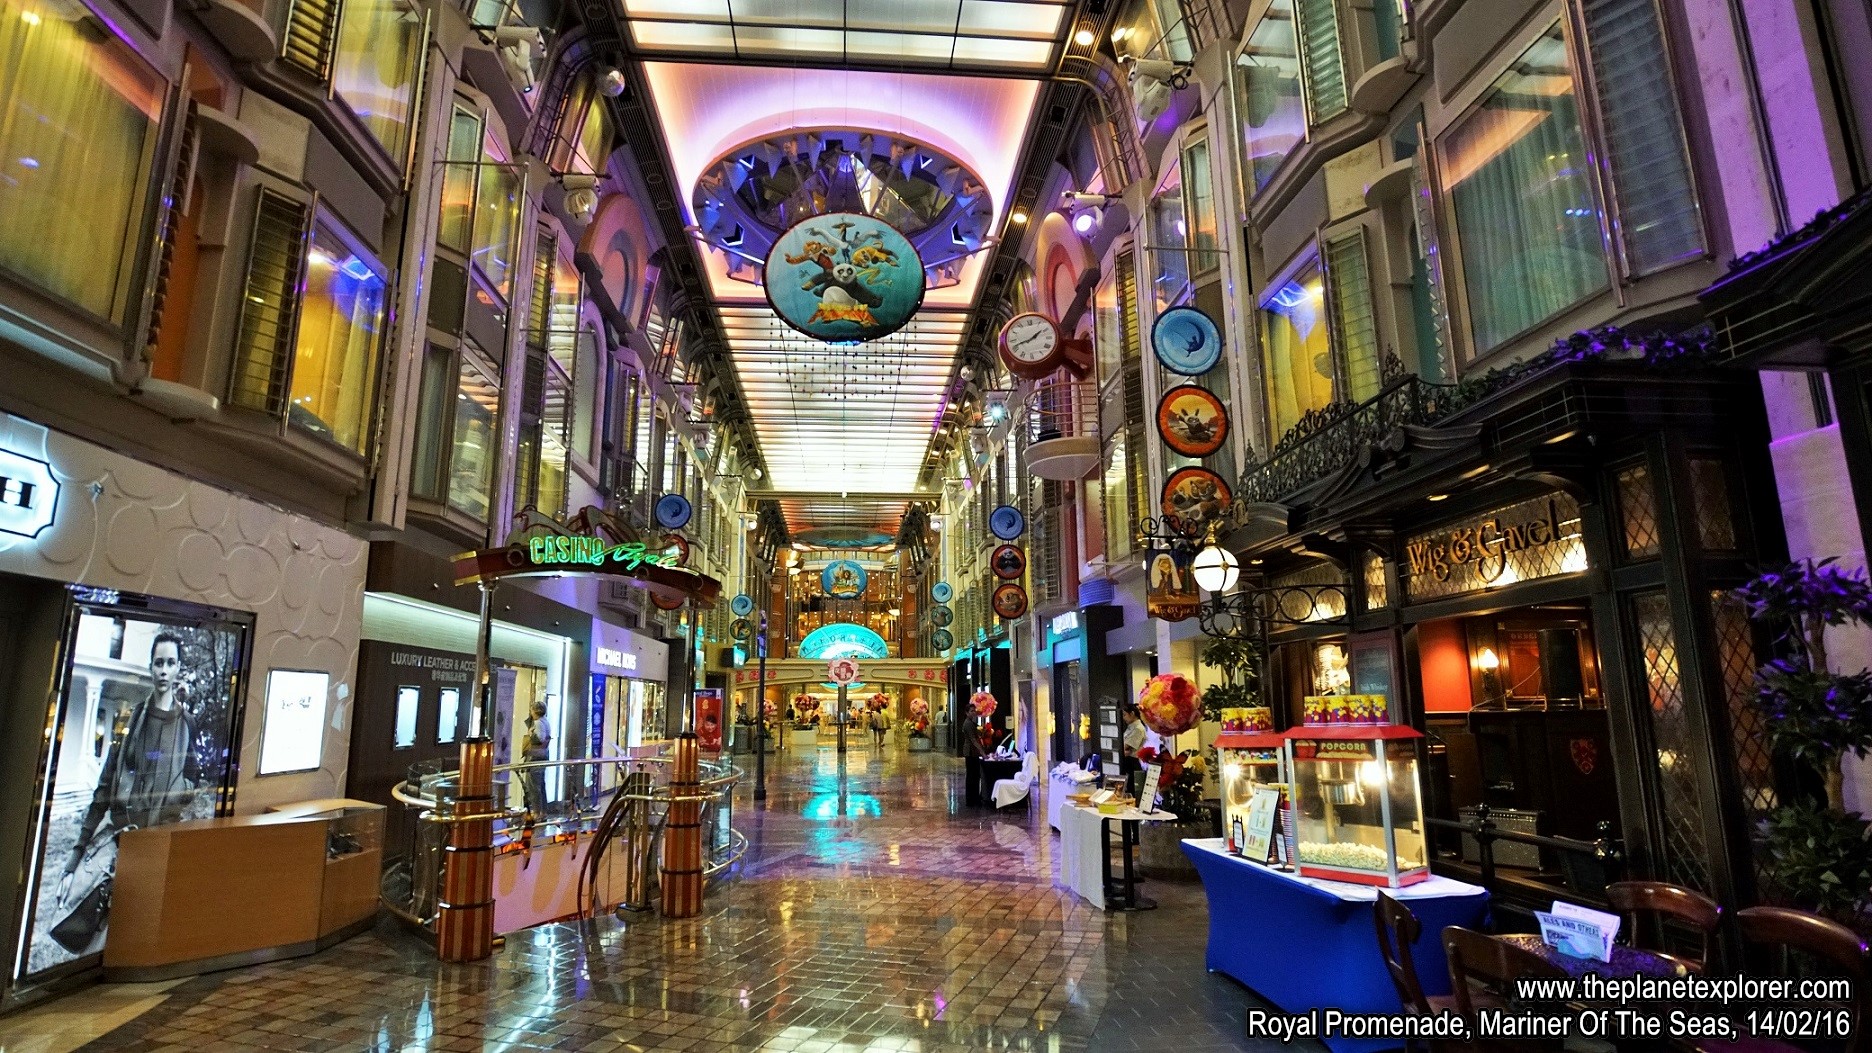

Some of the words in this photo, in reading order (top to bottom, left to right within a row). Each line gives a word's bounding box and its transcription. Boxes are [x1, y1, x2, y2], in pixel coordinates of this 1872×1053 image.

[529, 536, 606, 566] CASINO
[598, 542, 688, 573] Royale
[1406, 539, 1449, 582] Wig
[1451, 527, 1472, 564] &
[1474, 499, 1561, 583] Gavel
[391, 651, 422, 667] LUXURY
[423, 655, 453, 670] LEATHER
[1321, 742, 1366, 750] POPCORN
